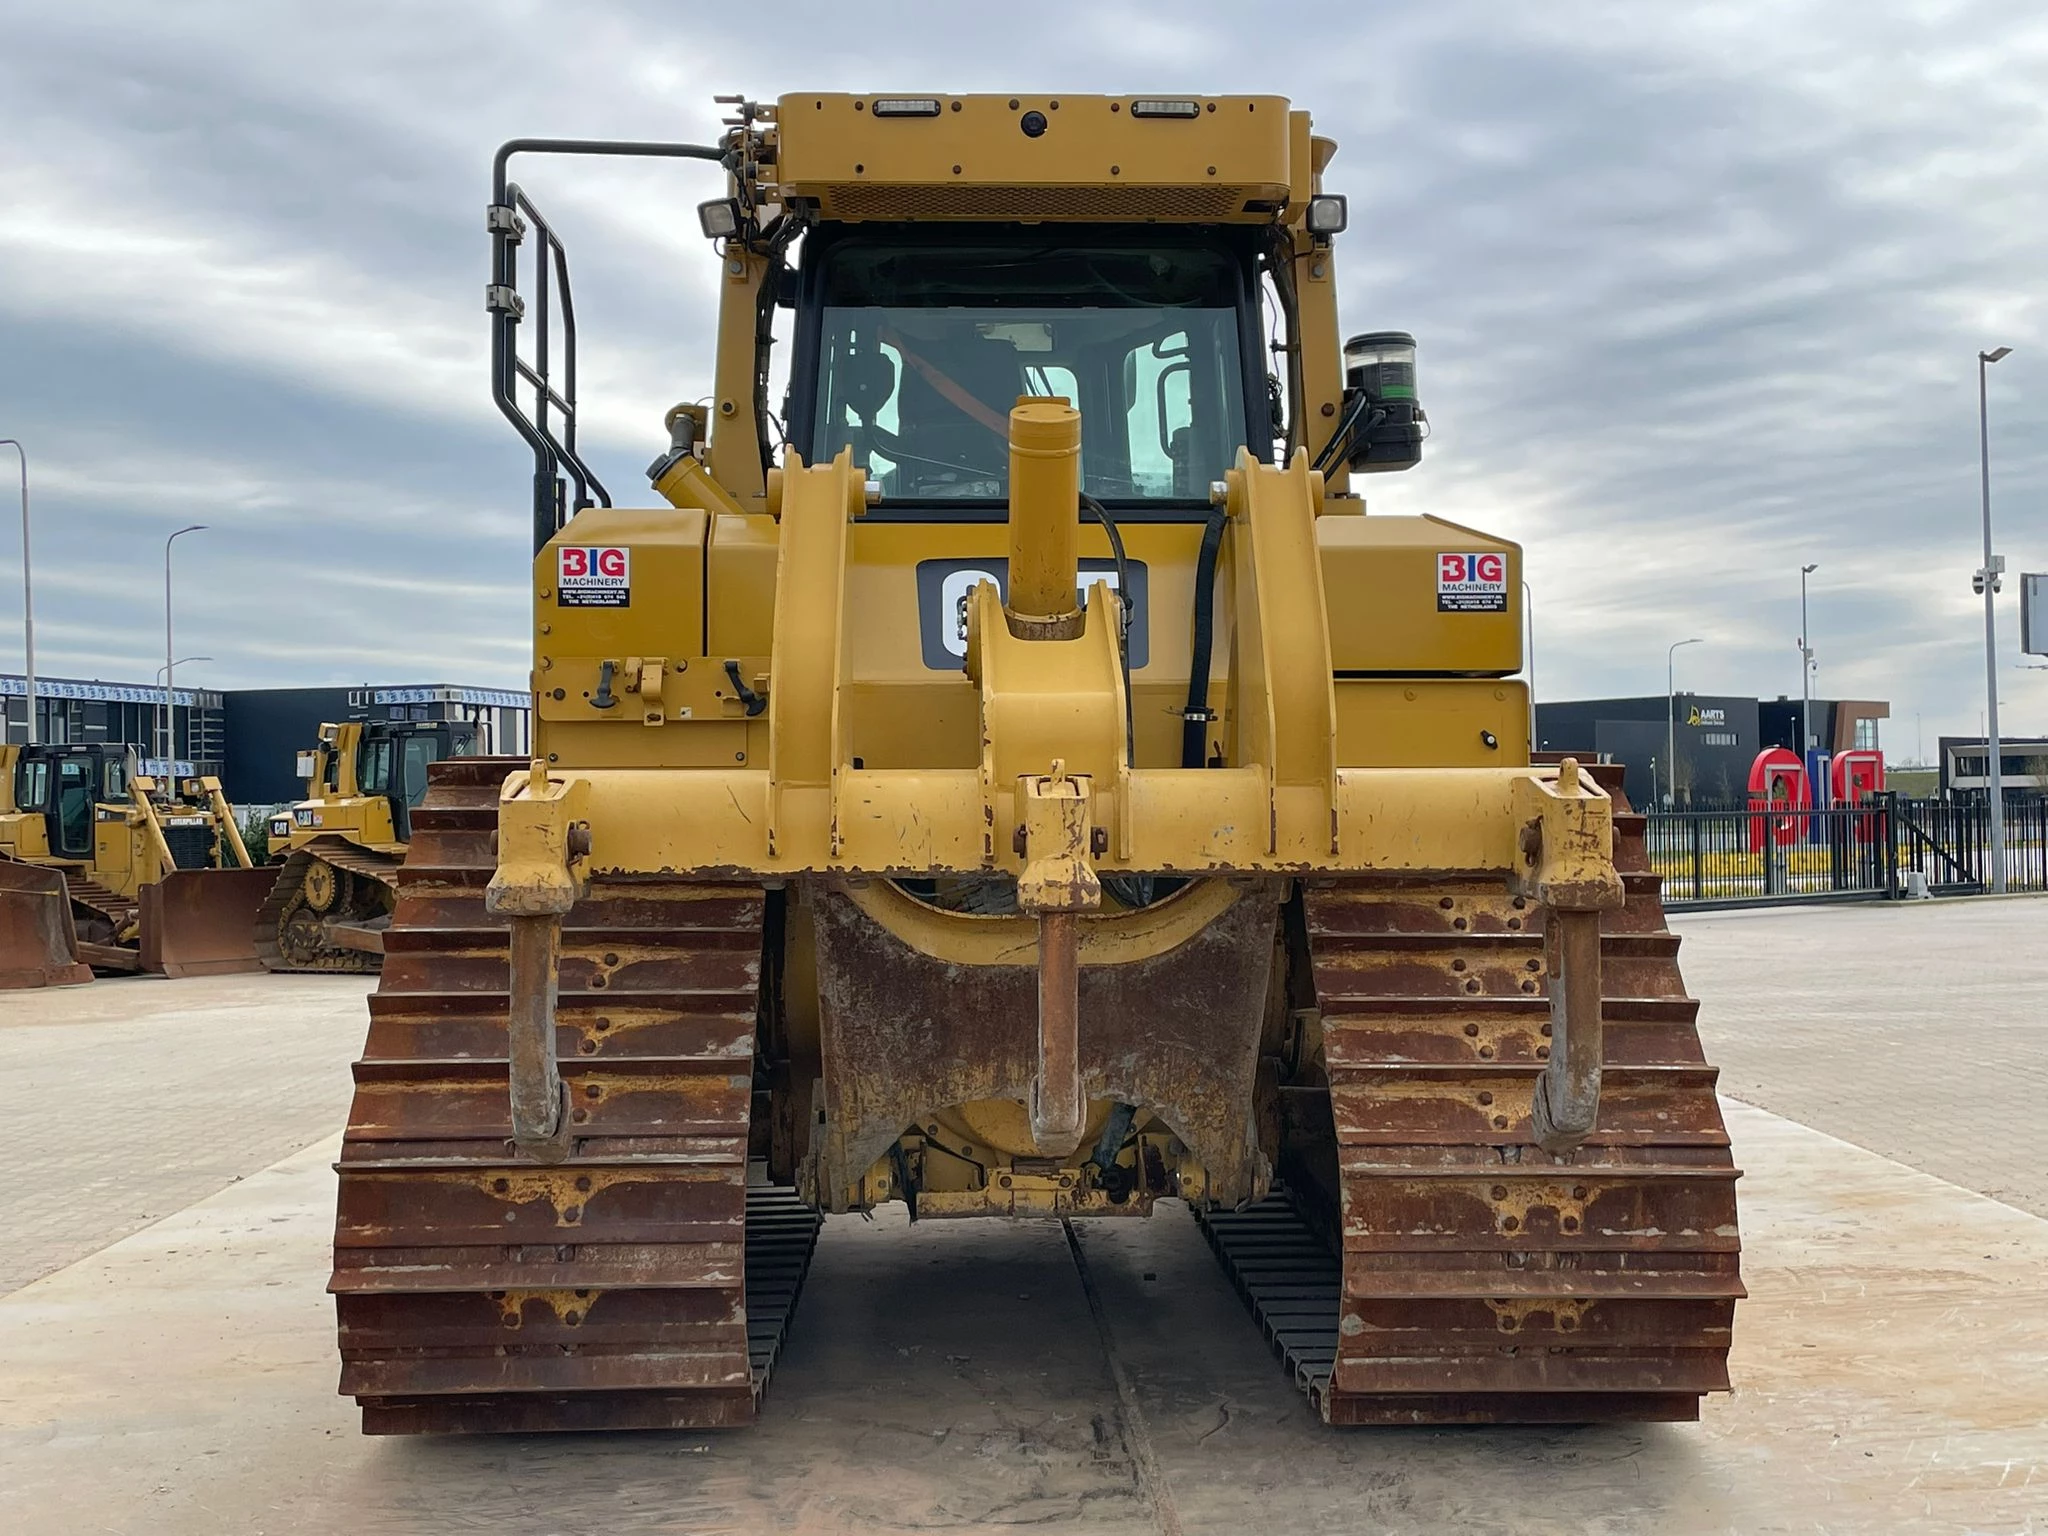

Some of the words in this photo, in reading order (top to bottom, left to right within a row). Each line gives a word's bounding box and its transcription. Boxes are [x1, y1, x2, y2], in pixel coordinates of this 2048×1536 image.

[563, 549, 625, 577] BIG
[1442, 555, 1502, 582] BIG
[563, 578, 624, 586] MACHINERY
[1442, 583, 1502, 591] MACHINERY
[1701, 709, 1725, 720] AARTS
[170, 817, 203, 825] CATERPILLAR
[298, 811, 312, 826] CAT
[274, 822, 287, 835] CAT
